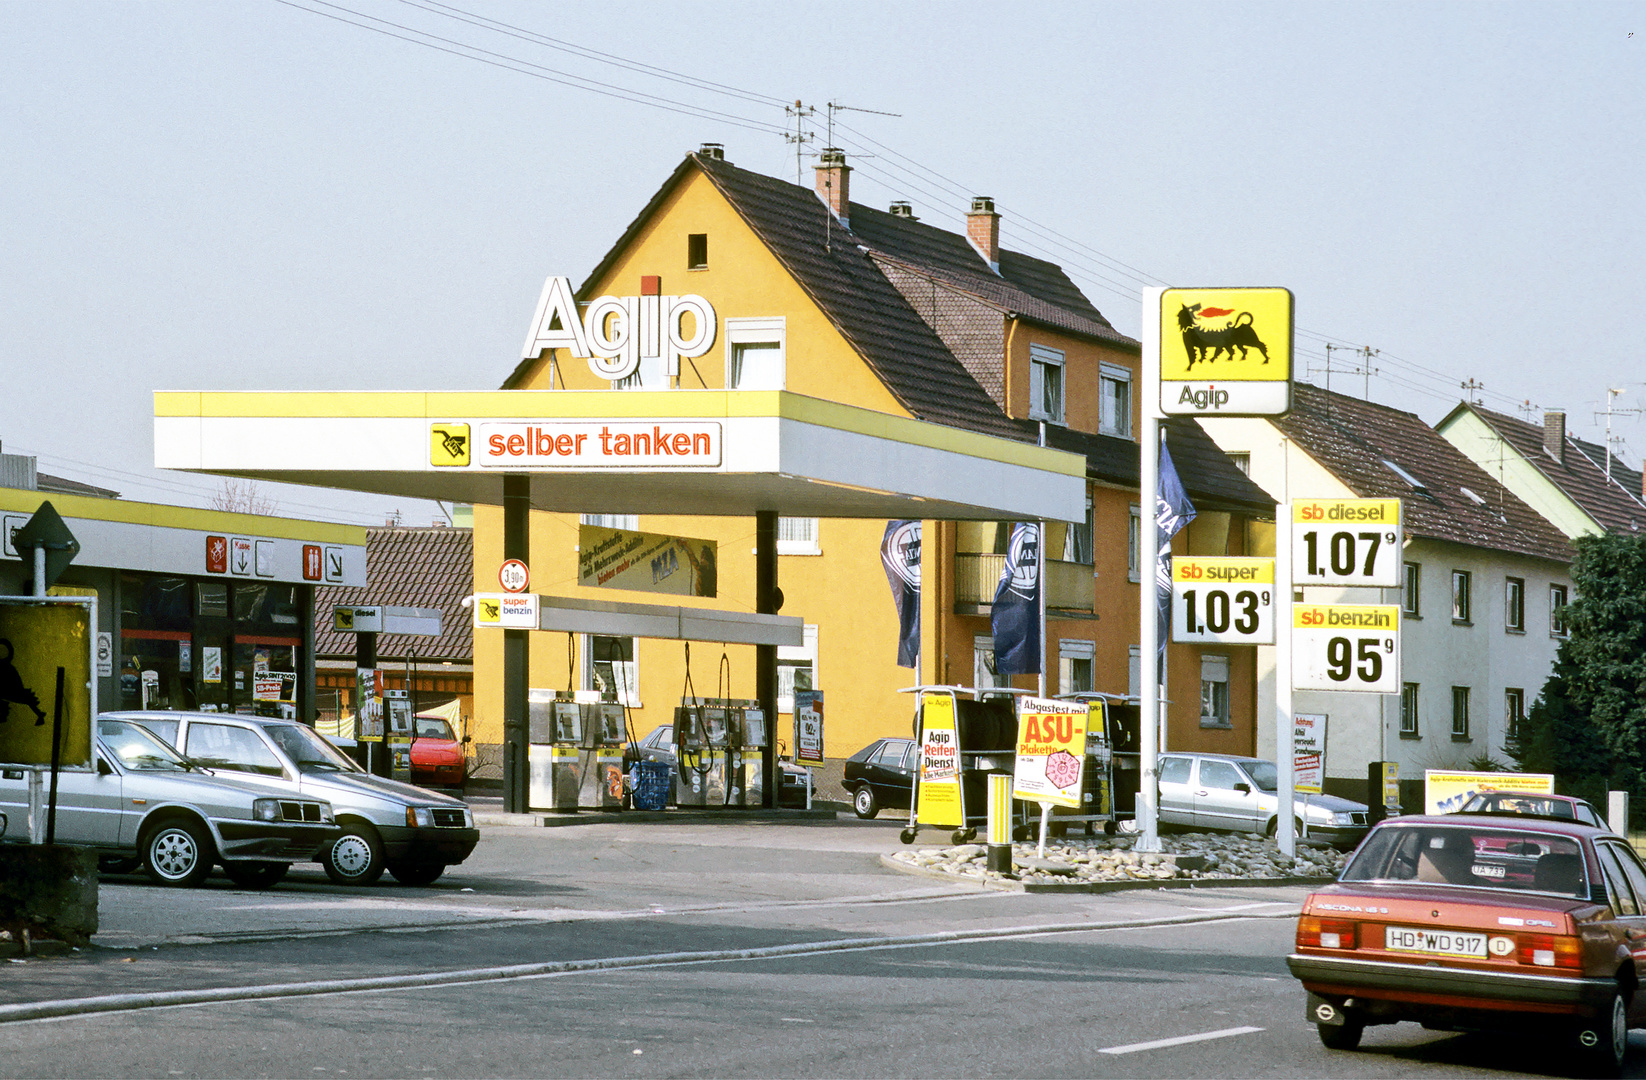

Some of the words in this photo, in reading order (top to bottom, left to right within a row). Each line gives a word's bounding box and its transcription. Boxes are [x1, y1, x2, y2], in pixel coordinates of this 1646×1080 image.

[520, 275, 717, 381] Agip
[1178, 384, 1229, 409] Agip
[488, 426, 588, 456] selber
[598, 426, 711, 455] tanken
[1301, 503, 1325, 520] sb
[1328, 503, 1385, 520] diesel
[1303, 531, 1382, 578] 1,07
[1181, 563, 1203, 579] sb
[1206, 567, 1259, 583] super
[503, 598, 528, 606] super
[354, 609, 376, 617] diesel
[503, 606, 532, 615] benzin
[1183, 590, 1259, 635] 1,03
[1301, 608, 1325, 625] sb
[1328, 608, 1390, 627] benzin
[1327, 636, 1383, 682] 95
[935, 699, 951, 707] Agip
[1024, 699, 1069, 714] Abgastest
[1025, 715, 1083, 743] ASU-
[929, 731, 950, 743] Agip
[924, 744, 956, 756] Reifen
[1020, 744, 1058, 754] Plakette
[925, 757, 954, 768] Dienst
[1316, 903, 1363, 913] ASCONA
[1525, 918, 1557, 927] OPEL
[1455, 936, 1481, 953] 917
[1496, 940, 1506, 952] D
